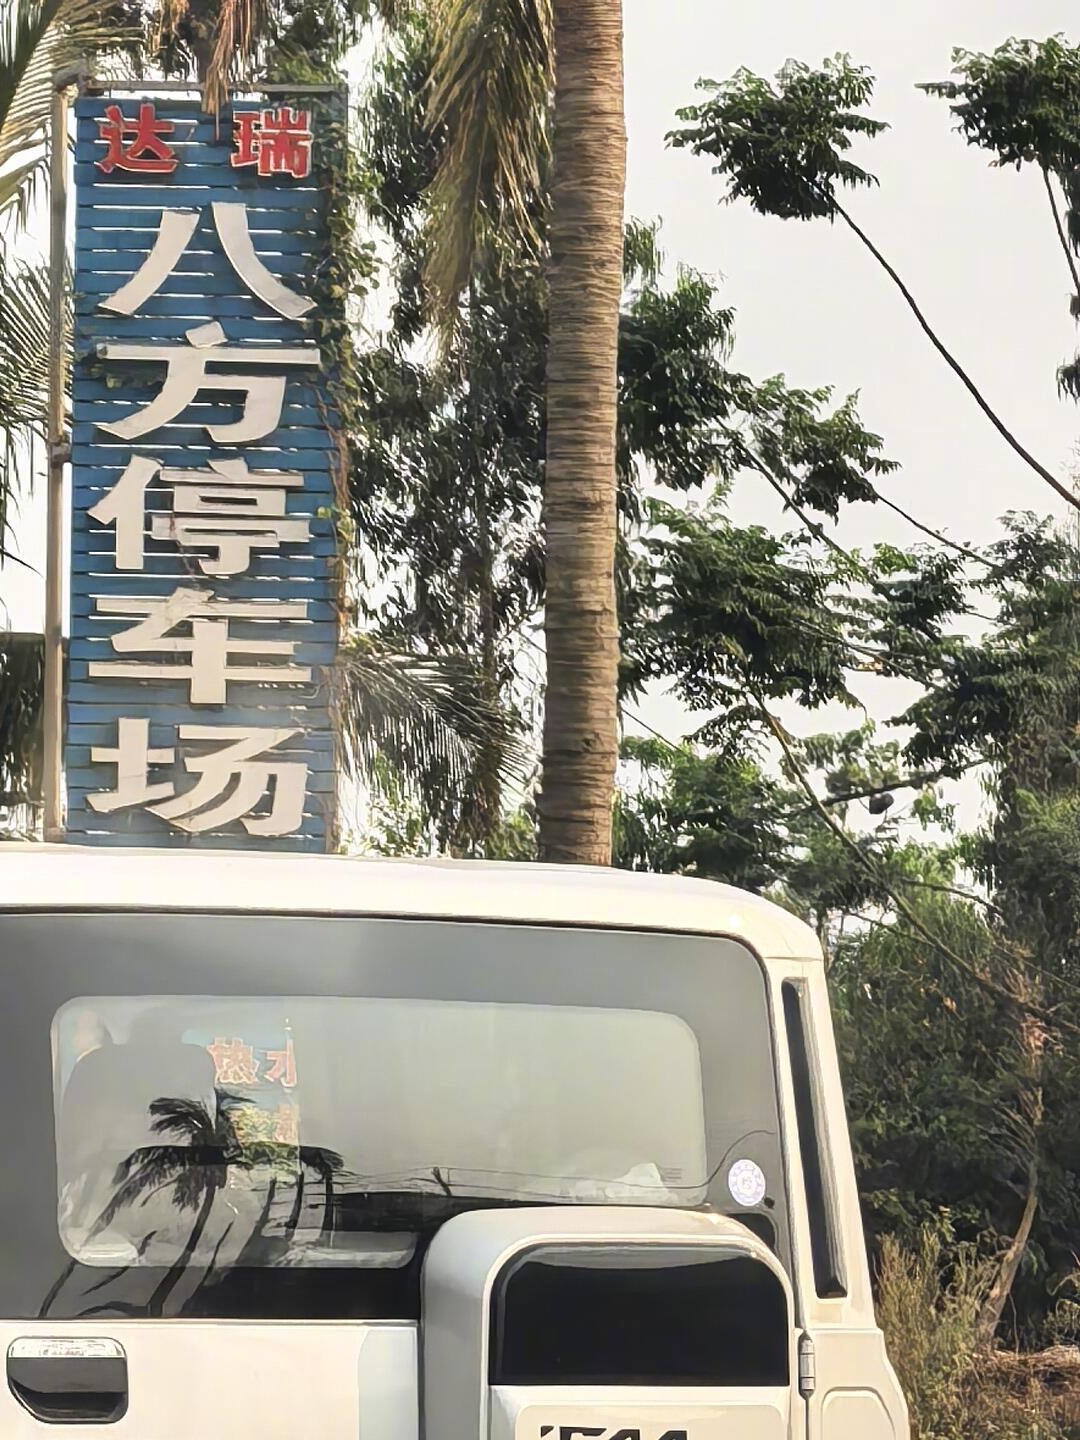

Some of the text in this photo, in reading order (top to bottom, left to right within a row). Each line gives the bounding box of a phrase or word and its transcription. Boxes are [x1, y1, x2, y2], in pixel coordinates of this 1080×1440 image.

[86, 201, 320, 837] 八方停车场
